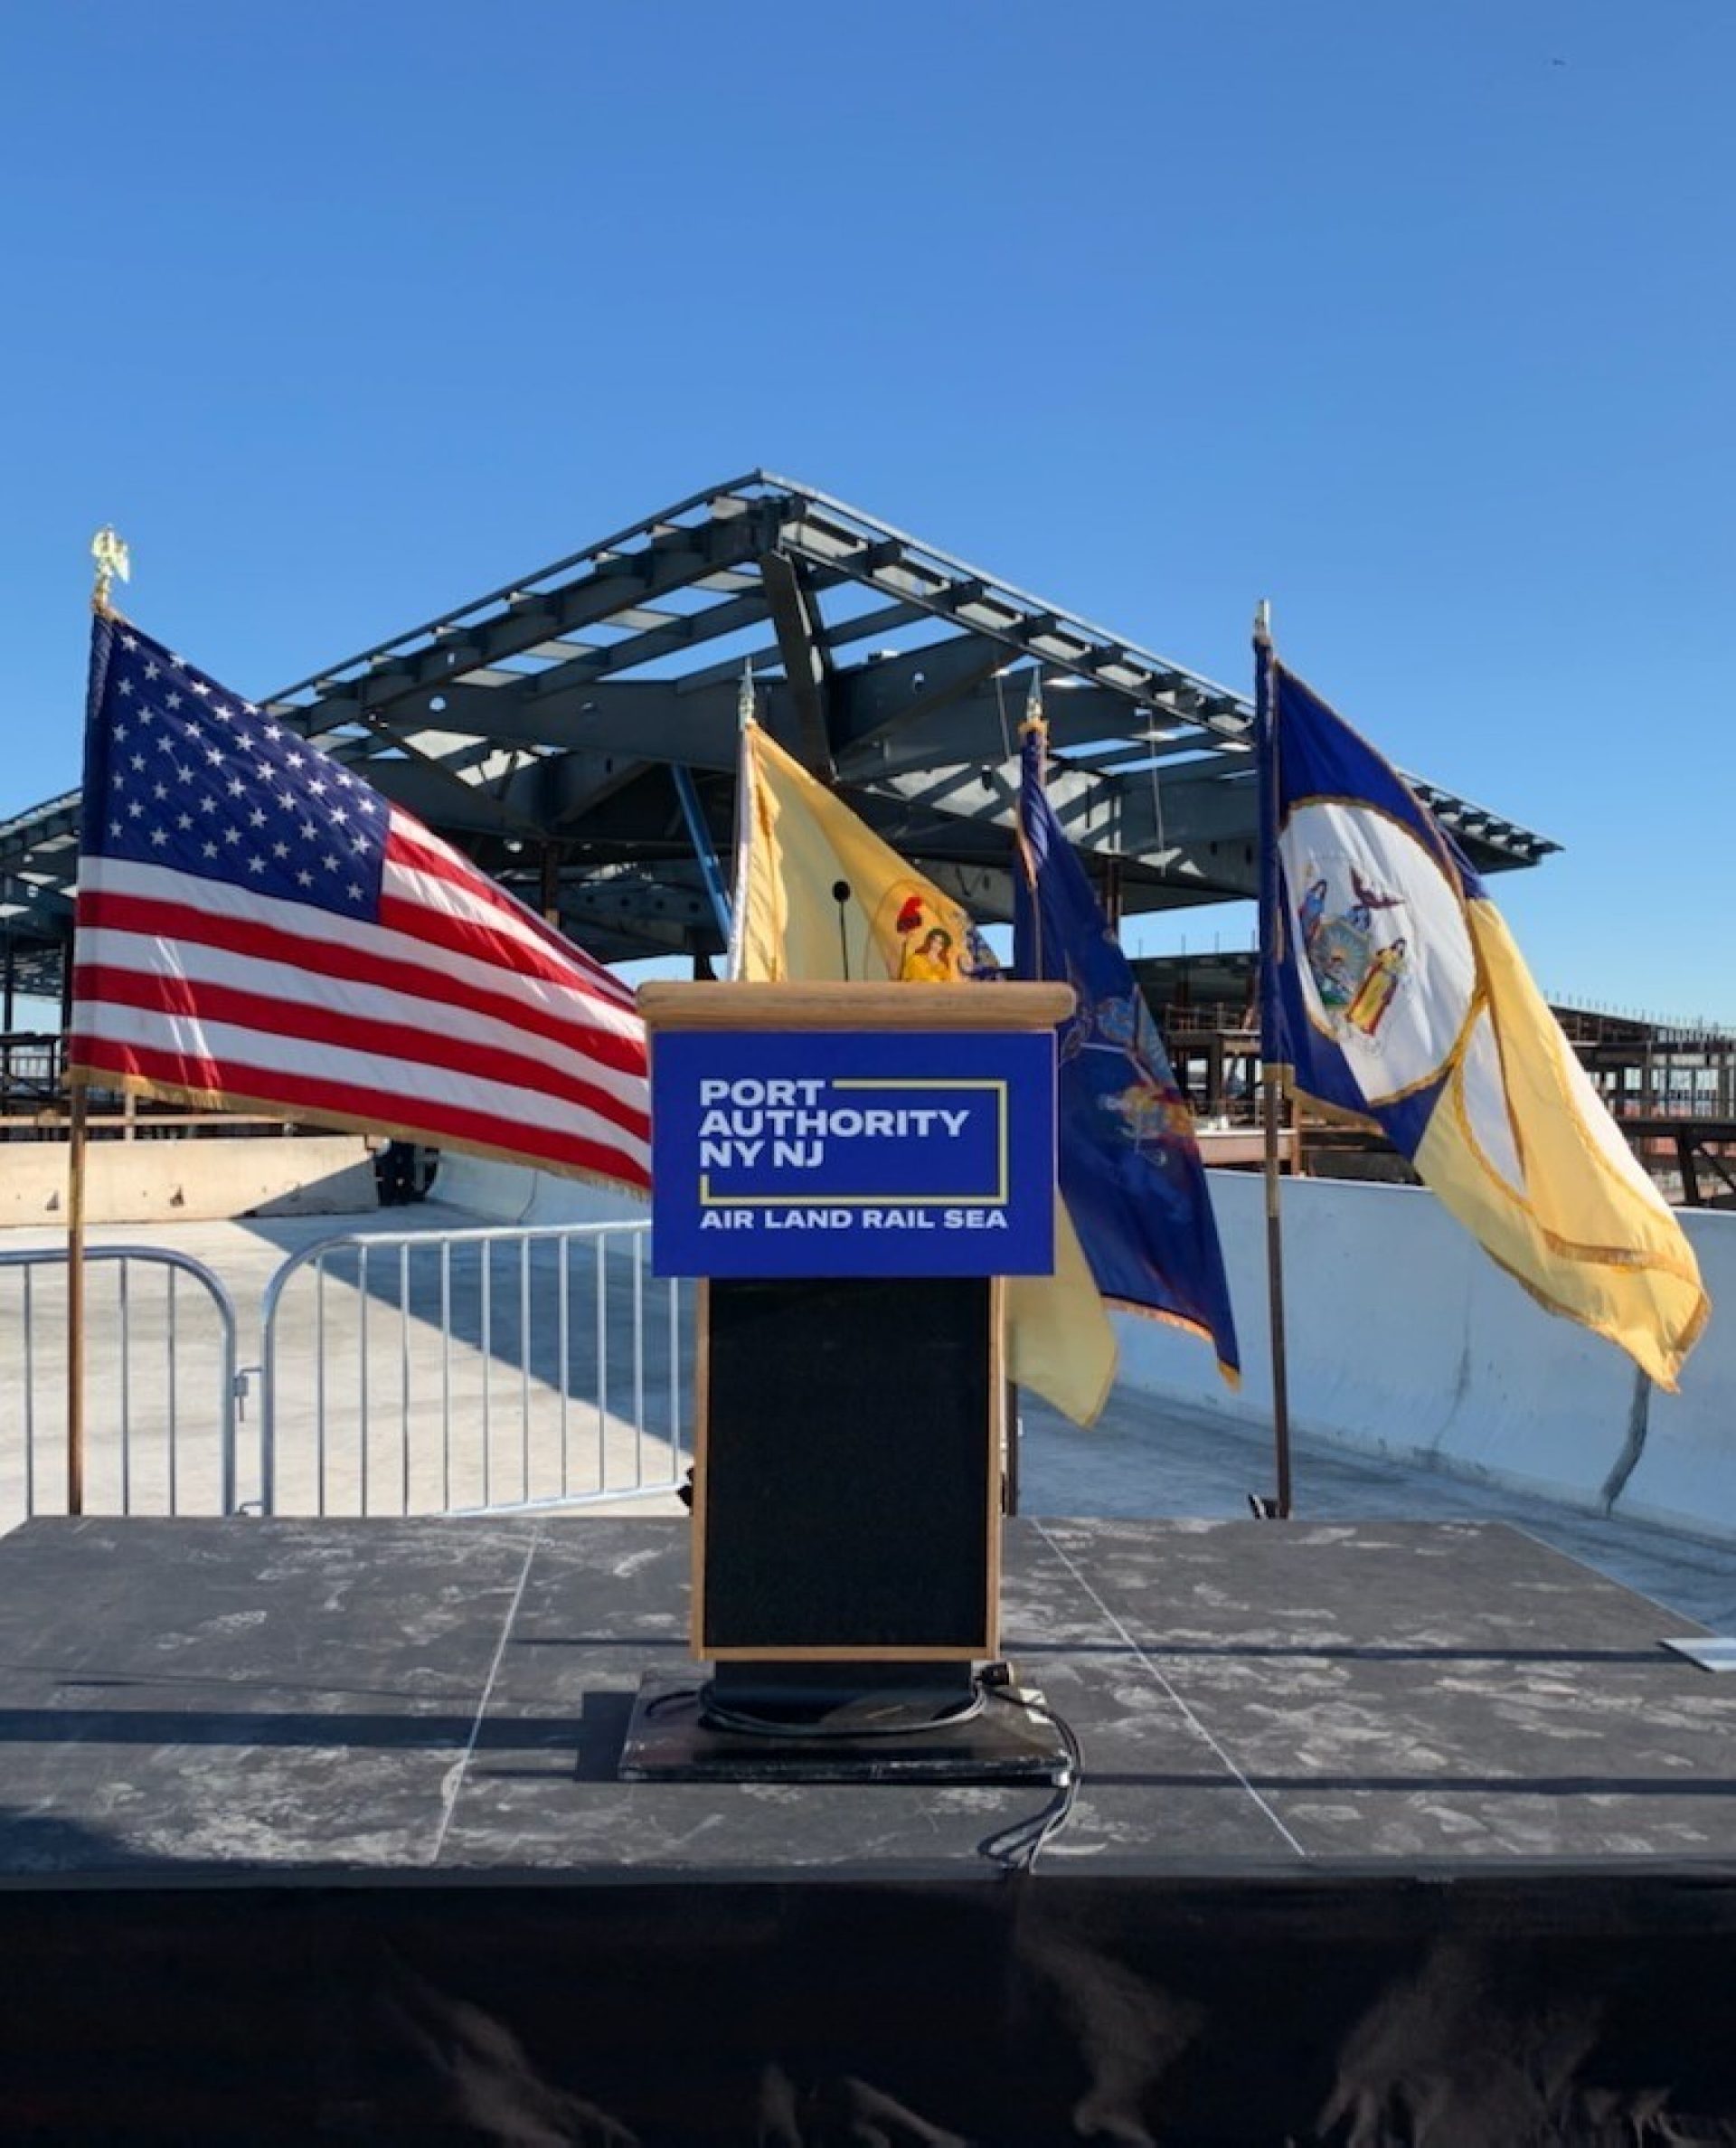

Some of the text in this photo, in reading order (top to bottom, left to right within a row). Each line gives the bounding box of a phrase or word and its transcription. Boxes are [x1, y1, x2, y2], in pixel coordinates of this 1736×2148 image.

[700, 1080, 826, 1106] PORT
[699, 1109, 969, 1138] AUTHORITY
[700, 1140, 824, 1168] NY NJ
[700, 1209, 1007, 1229] AIR LAND RAIL SEA
